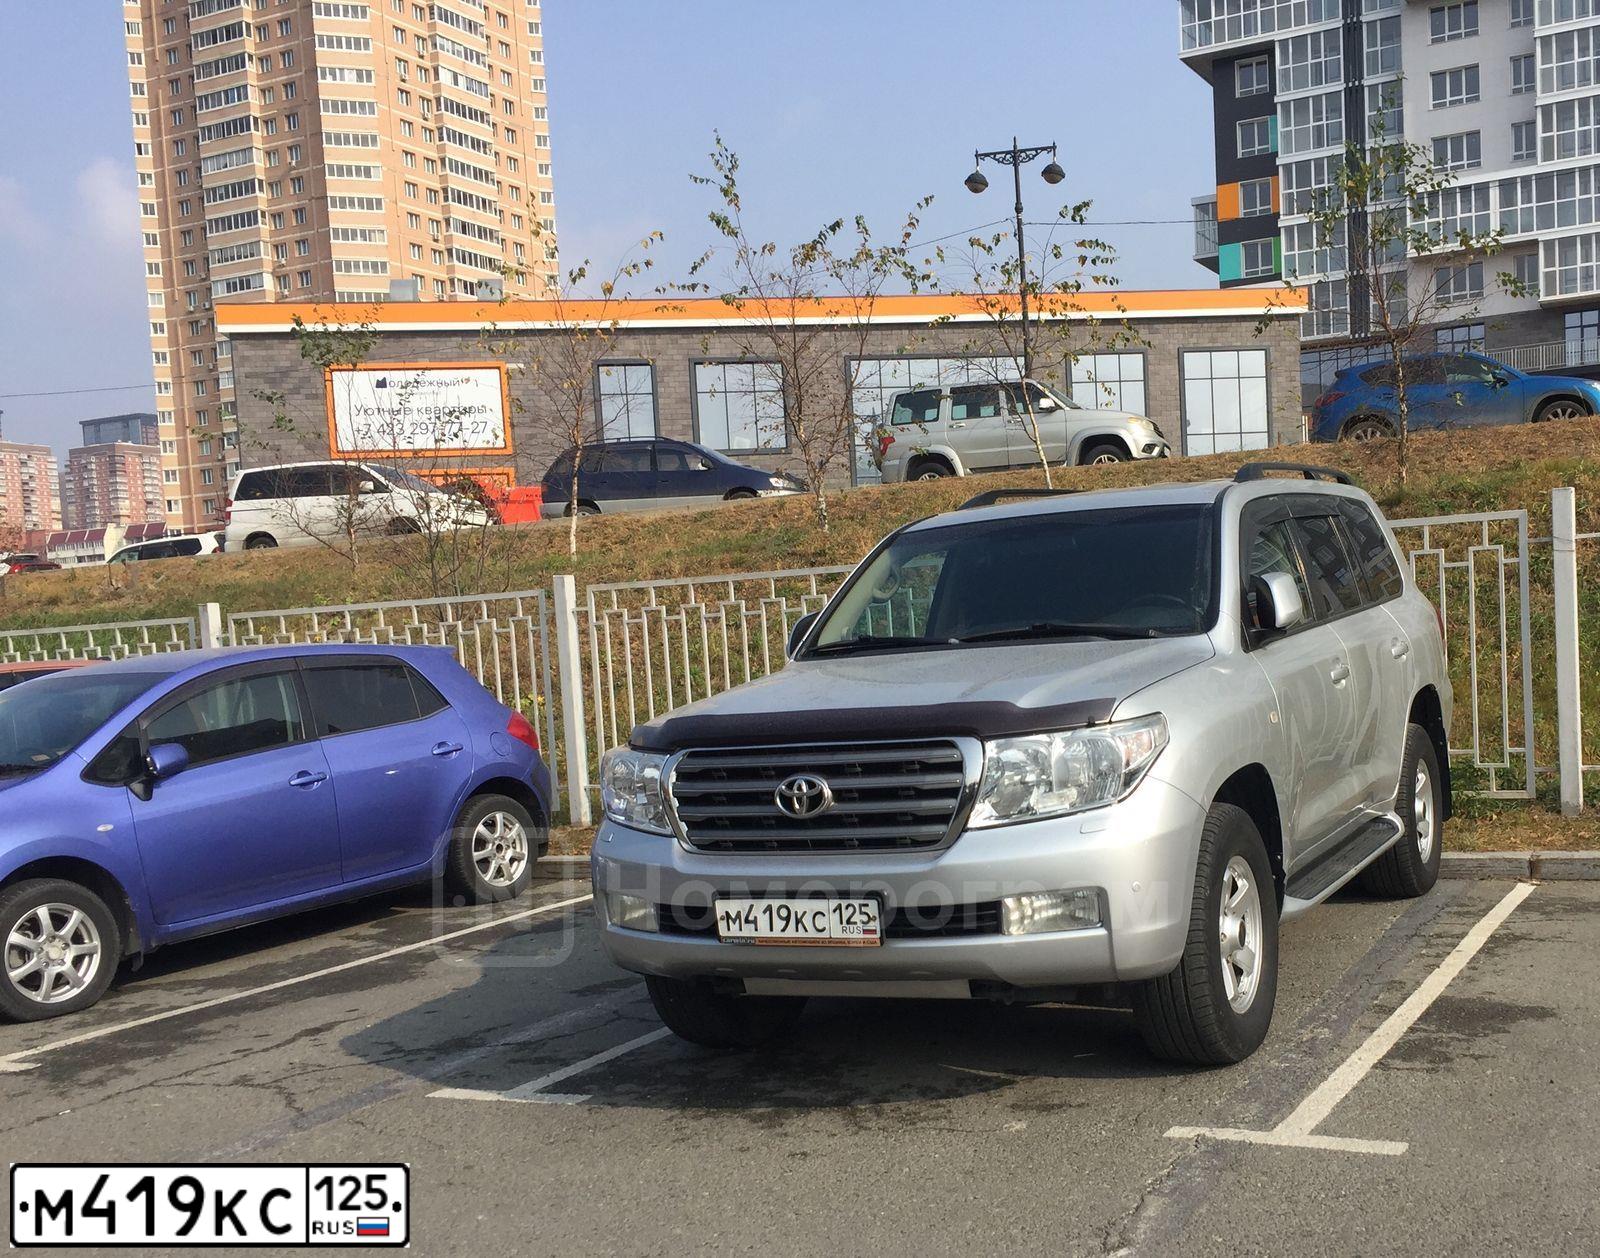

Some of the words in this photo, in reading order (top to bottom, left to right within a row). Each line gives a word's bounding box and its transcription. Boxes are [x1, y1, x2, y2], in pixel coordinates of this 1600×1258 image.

[354, 404, 411, 417] Уютные
[354, 423, 371, 436] +7
[377, 422, 405, 436] 423
[725, 904, 827, 933] М419КС
[832, 903, 871, 925] 125
[841, 926, 862, 935] RUS
